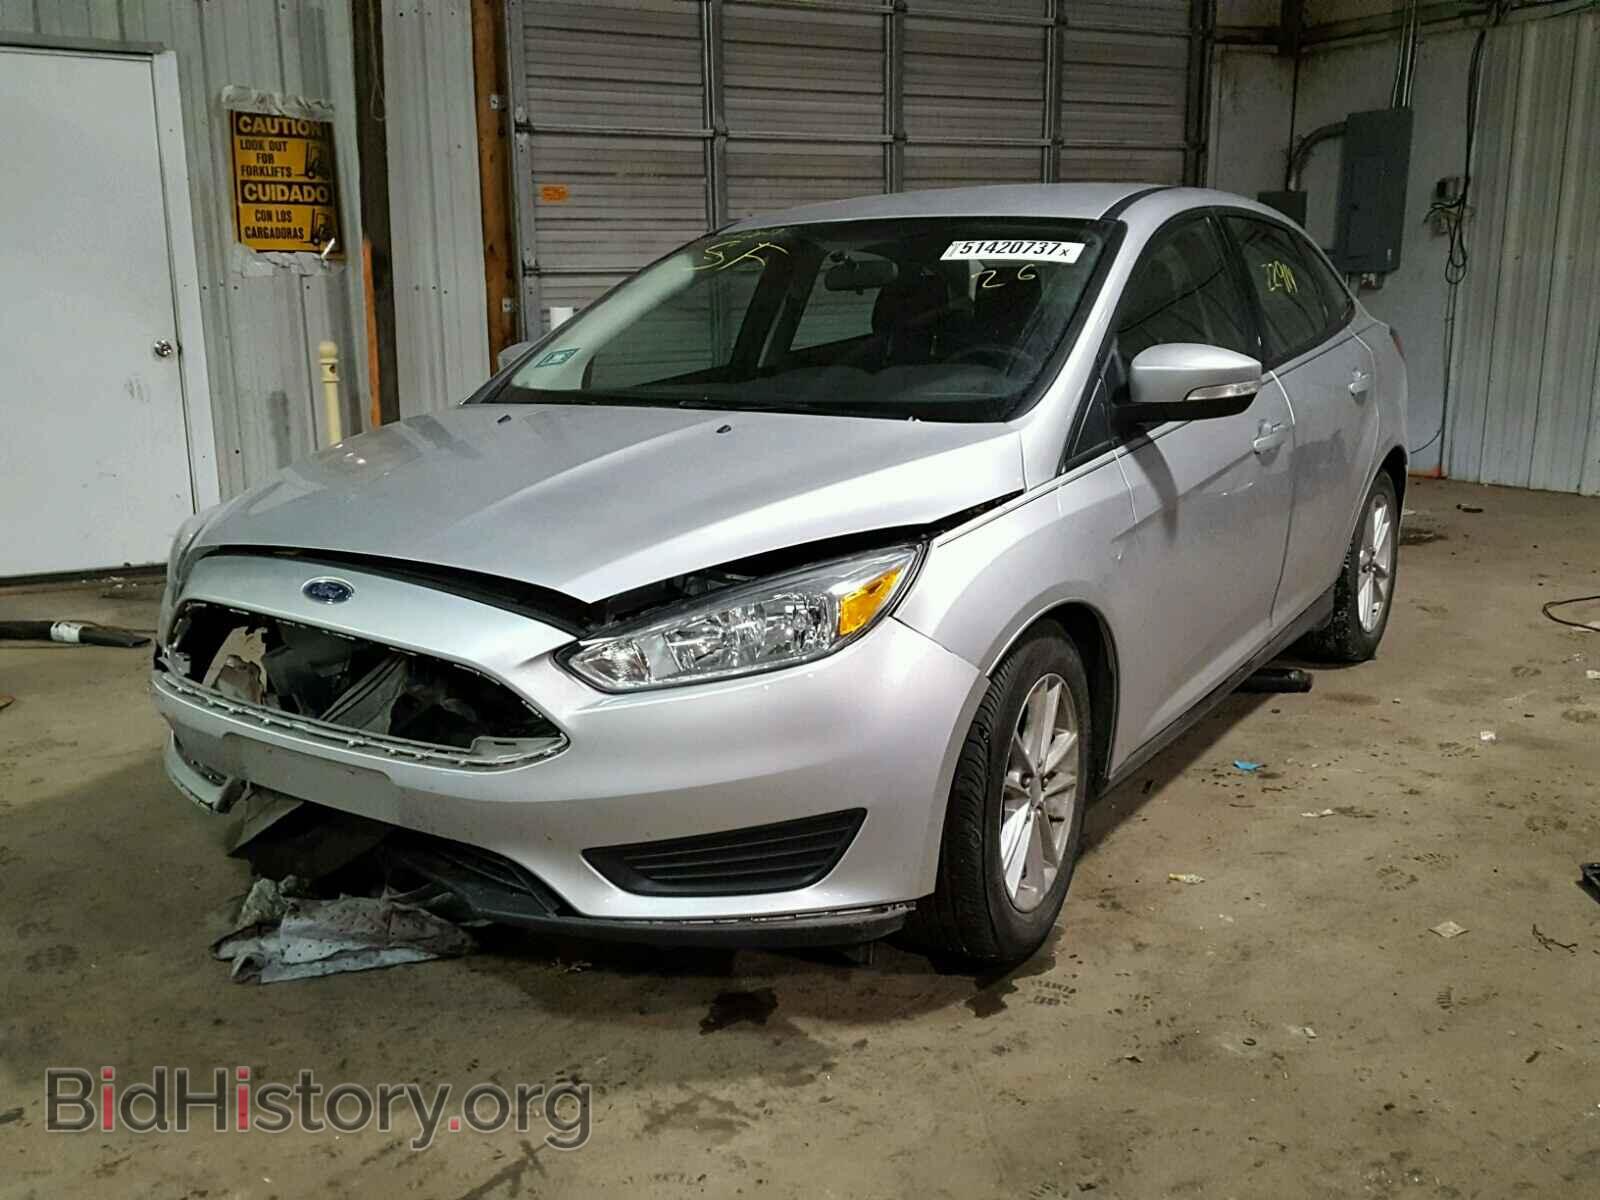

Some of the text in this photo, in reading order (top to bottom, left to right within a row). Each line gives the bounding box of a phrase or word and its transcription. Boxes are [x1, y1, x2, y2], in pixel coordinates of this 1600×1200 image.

[240, 139, 288, 151] LOOK OUT
[256, 153, 274, 164] FOR
[241, 167, 292, 177] FORKLIFTS
[243, 183, 328, 203] CUIDADO
[255, 209, 292, 223] CON LOS
